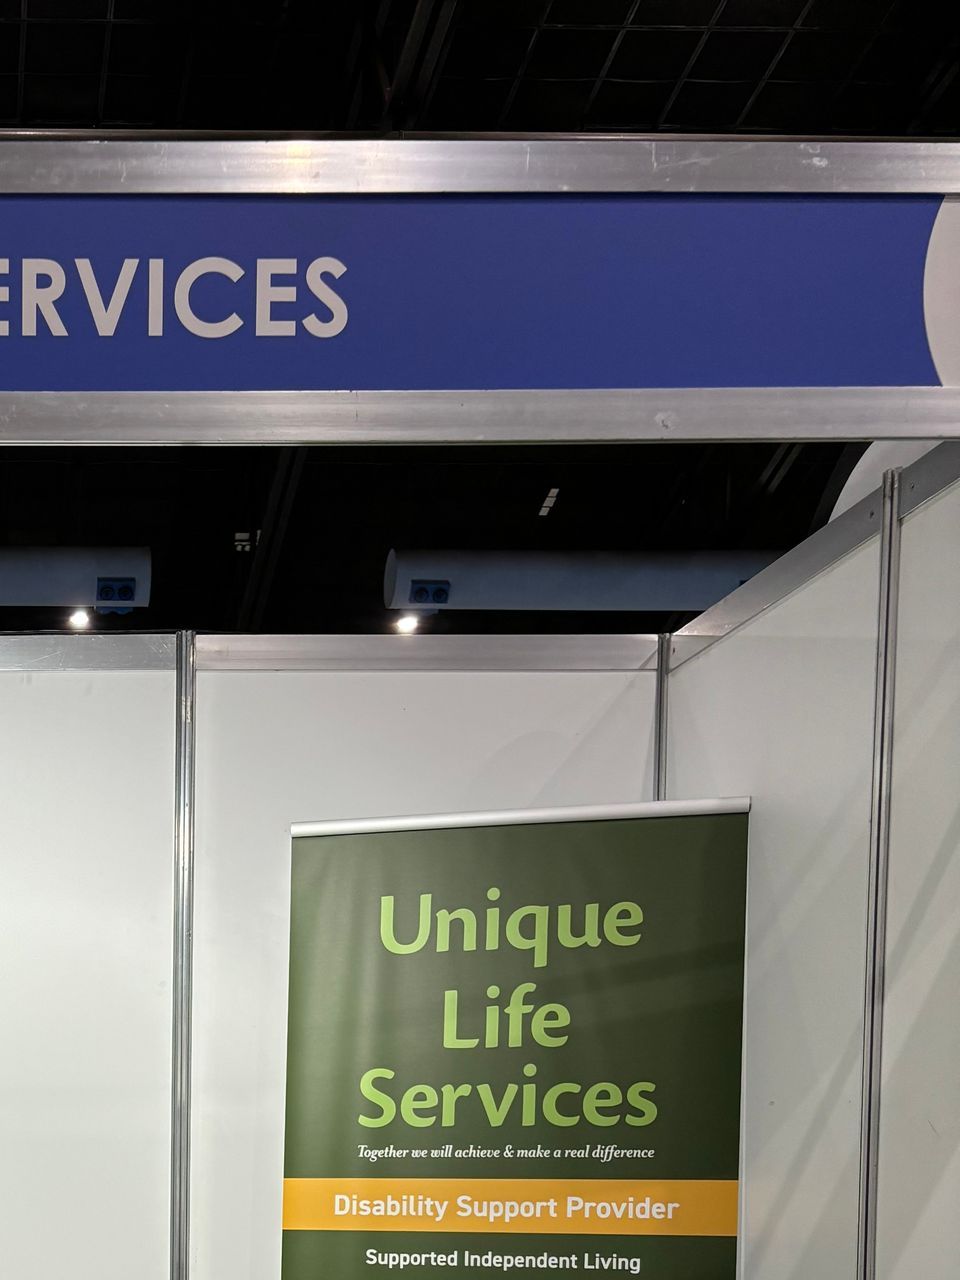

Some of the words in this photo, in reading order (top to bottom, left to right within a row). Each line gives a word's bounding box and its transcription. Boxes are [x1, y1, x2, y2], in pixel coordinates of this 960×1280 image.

[380, 887, 644, 968] Unique
[443, 982, 571, 1049] Life
[357, 1063, 658, 1129] Services
[357, 1144, 409, 1162] Together
[411, 1148, 428, 1158] we
[430, 1144, 453, 1158] will
[454, 1144, 500, 1158] achieve
[503, 1144, 514, 1158] &
[516, 1144, 551, 1158] make
[553, 1149, 562, 1158] a
[564, 1144, 590, 1158] real
[592, 1144, 655, 1163] difference
[333, 1194, 449, 1222] Disability
[456, 1195, 557, 1223] Support
[566, 1196, 681, 1220] Provider
[365, 1249, 458, 1269] Supported
[464, 1250, 578, 1272] Independent
[583, 1253, 641, 1274] Living
